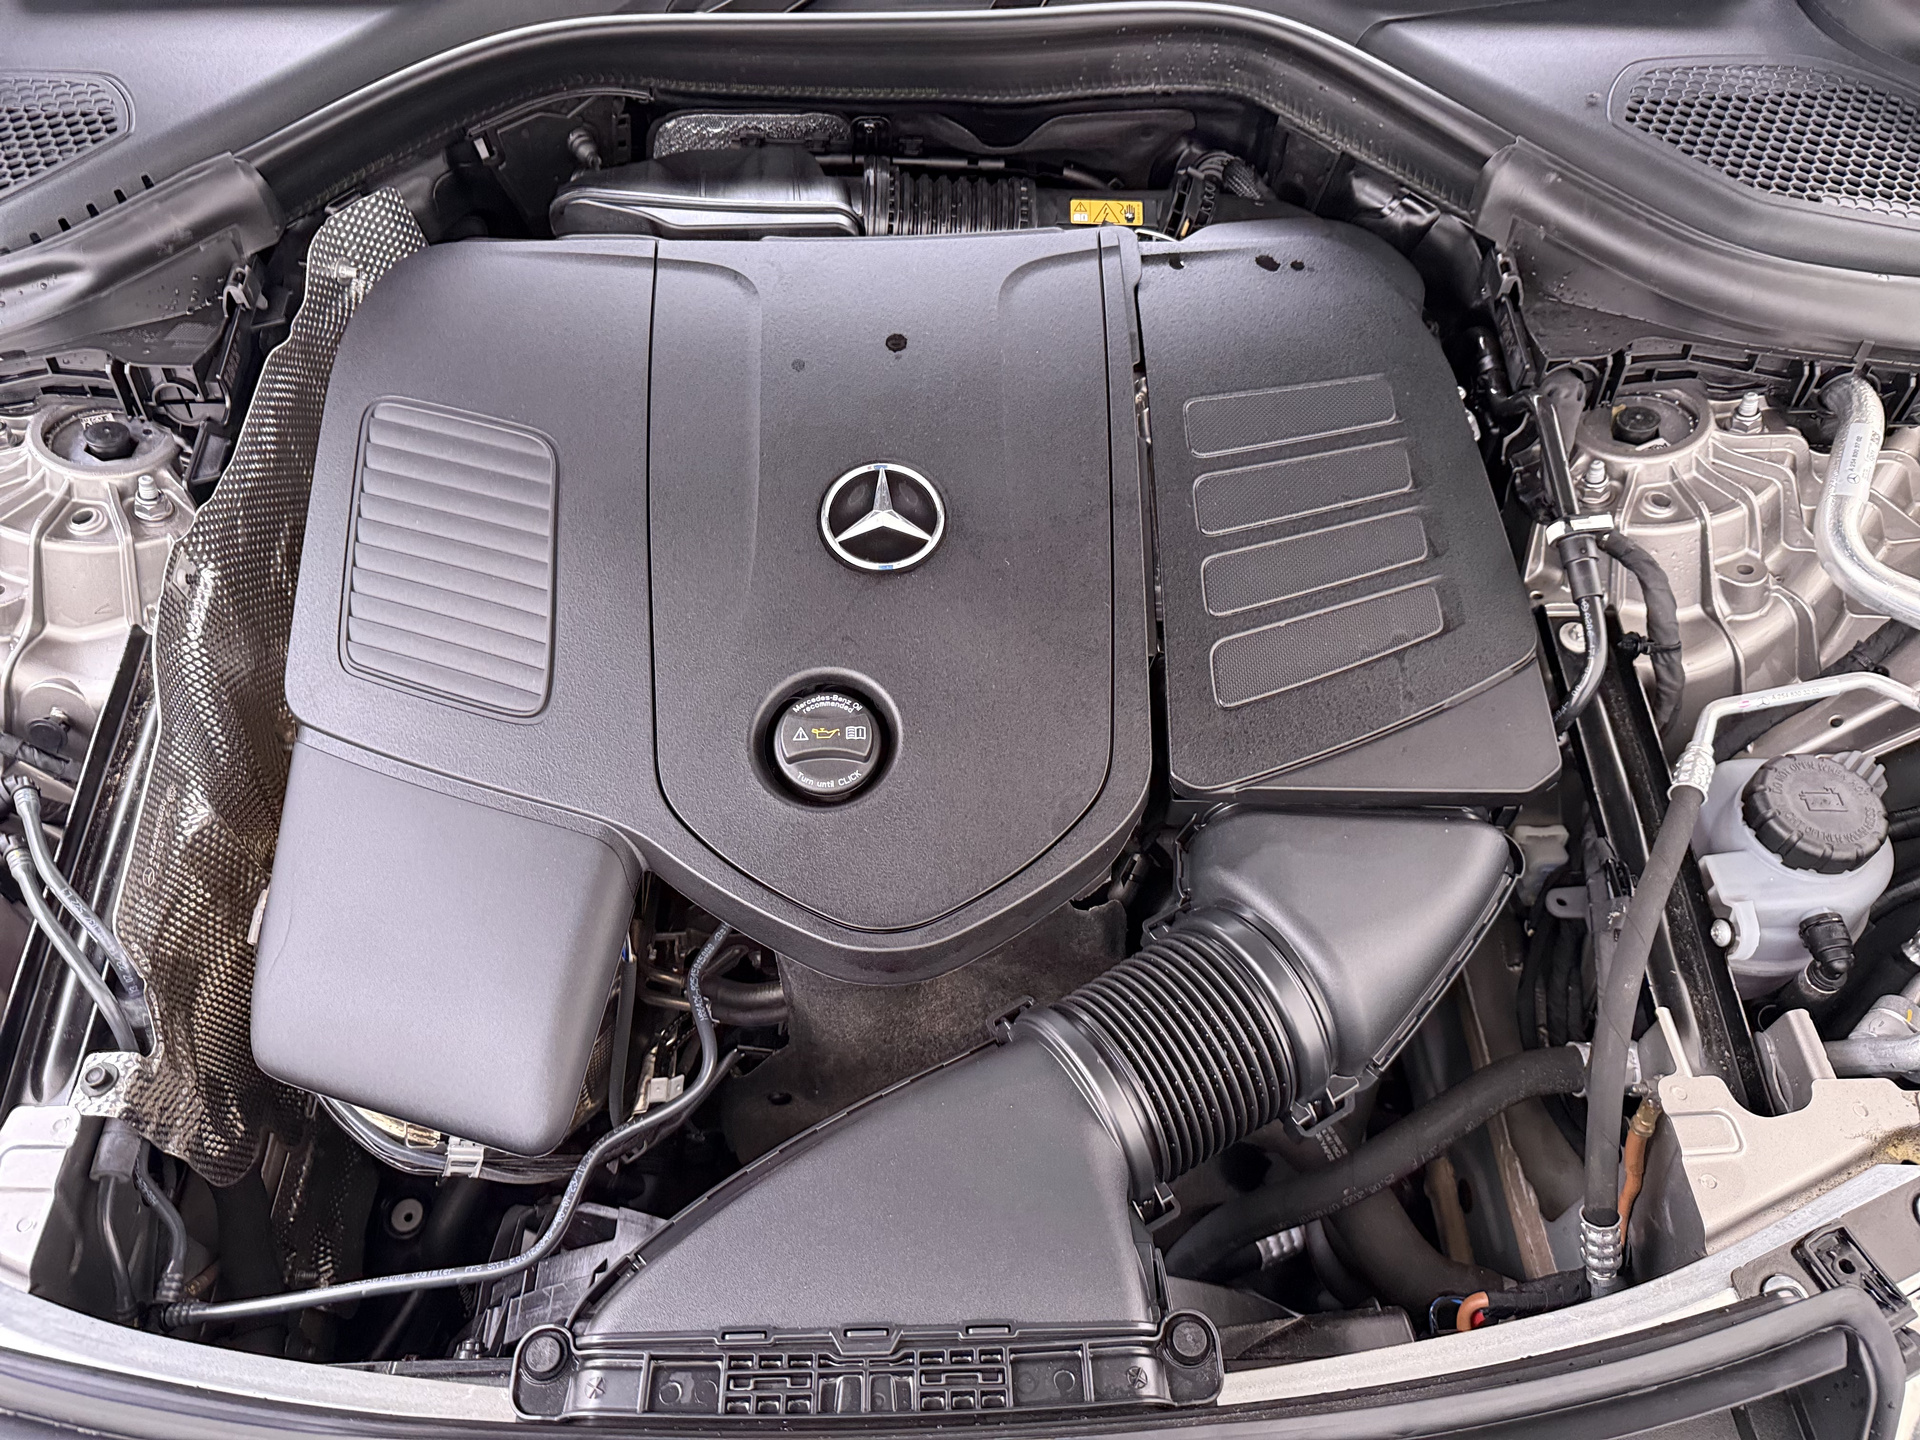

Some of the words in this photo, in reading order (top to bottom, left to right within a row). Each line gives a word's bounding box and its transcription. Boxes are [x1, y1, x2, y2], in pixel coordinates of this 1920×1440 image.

[792, 694, 852, 713] Mercedes-Benz
[802, 700, 855, 714] recommended
[797, 771, 814, 786] Turn
[816, 780, 835, 788] until
[838, 769, 862, 786] CLICK
